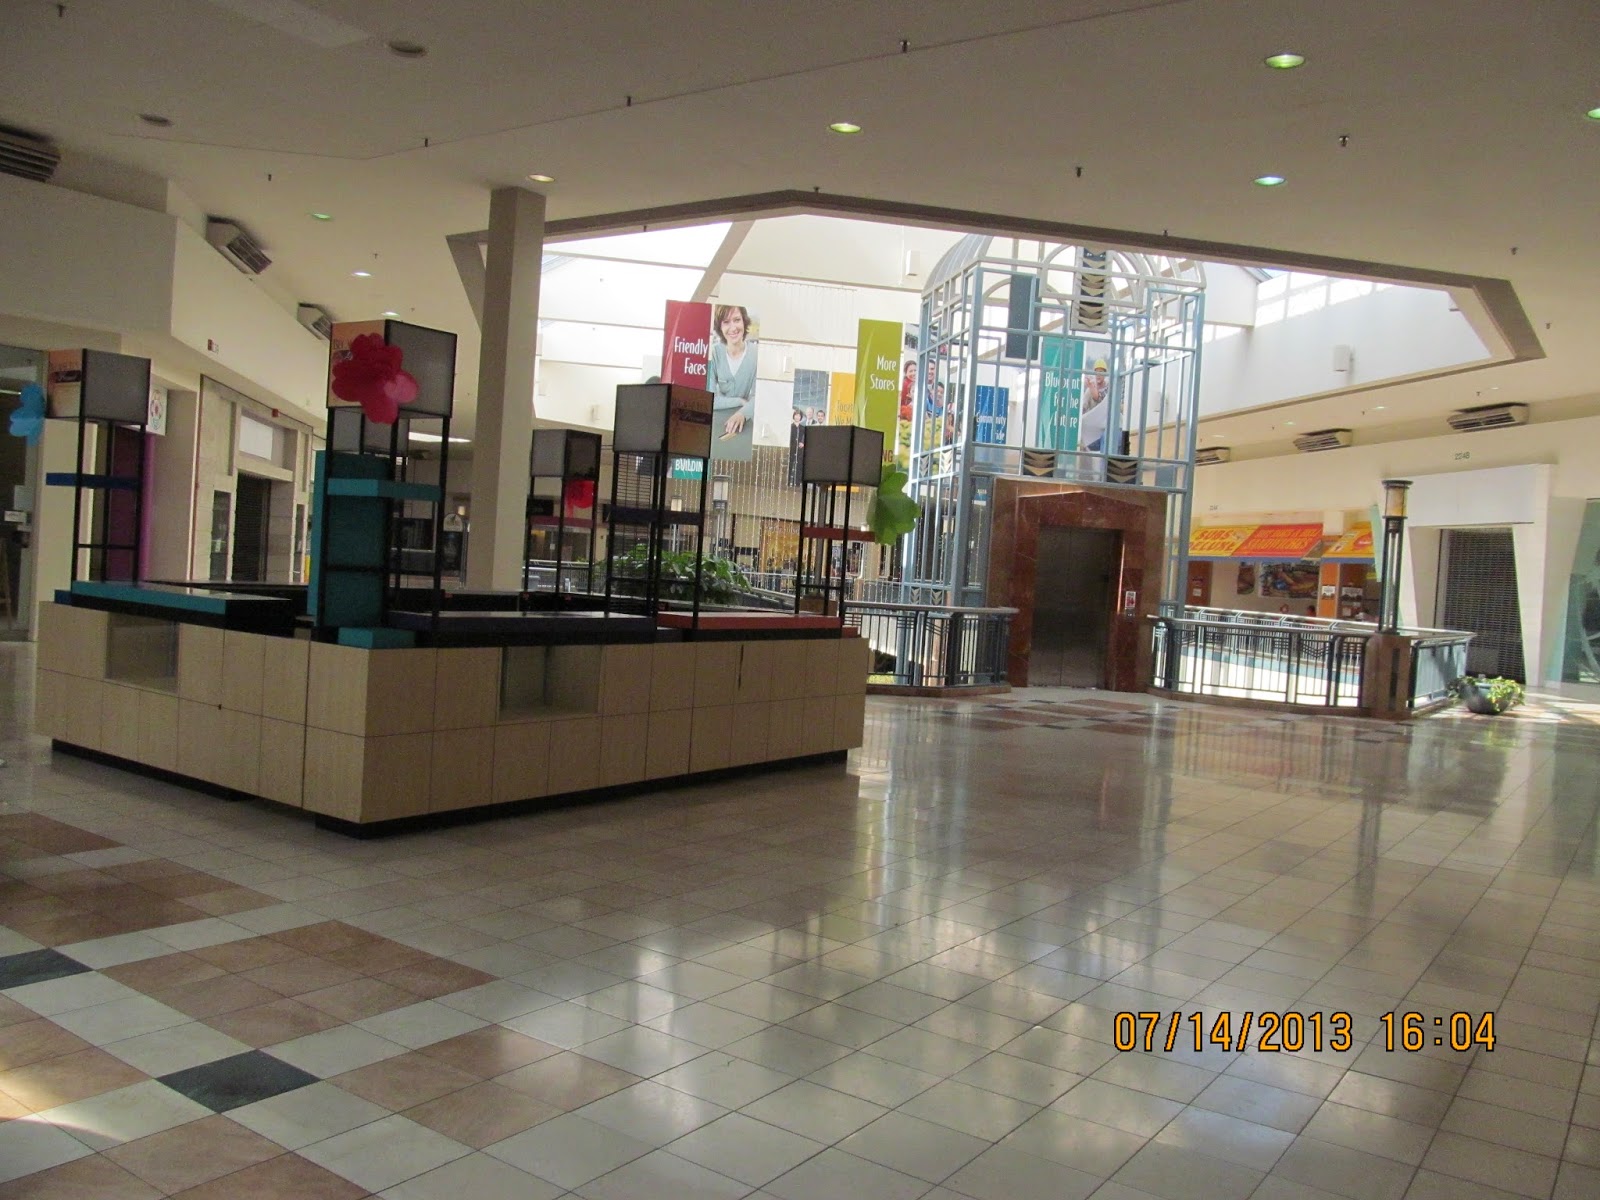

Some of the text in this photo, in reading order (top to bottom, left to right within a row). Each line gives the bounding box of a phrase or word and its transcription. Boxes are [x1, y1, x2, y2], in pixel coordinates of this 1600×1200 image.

[674, 336, 709, 358] Friendly
[684, 357, 707, 376] Faces
[876, 354, 897, 372] More
[870, 373, 895, 391] Stores
[674, 457, 704, 473] BUILDIN
[1195, 529, 1234, 540] SUBS
